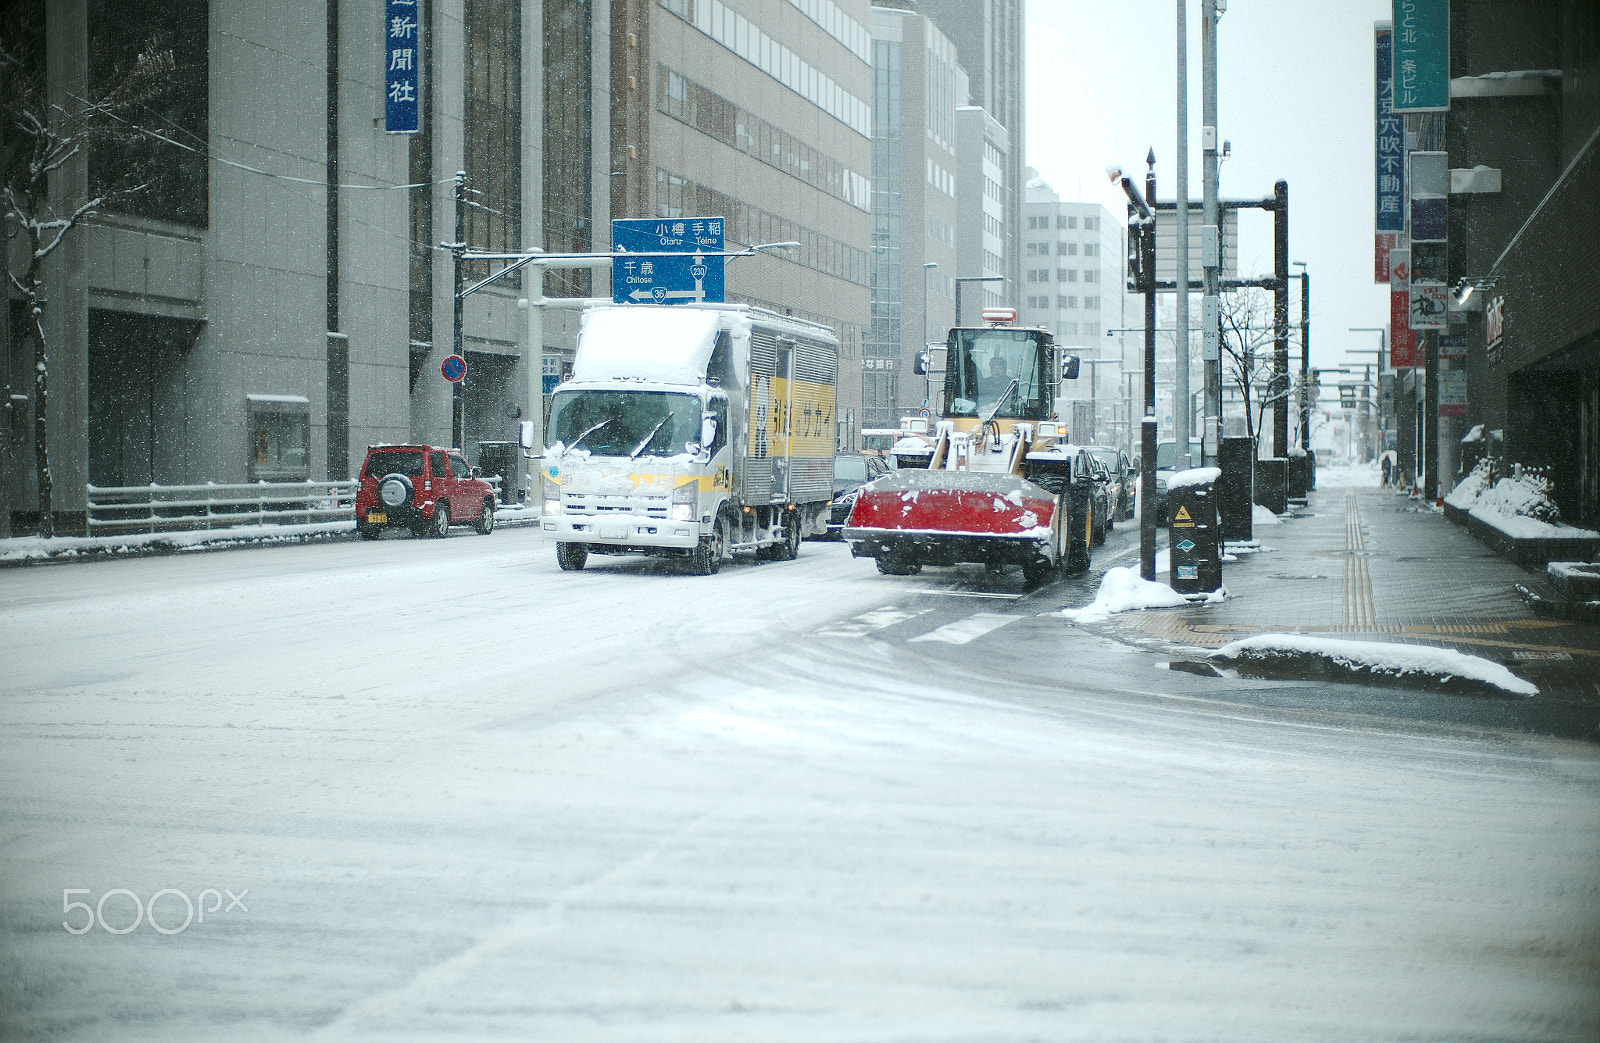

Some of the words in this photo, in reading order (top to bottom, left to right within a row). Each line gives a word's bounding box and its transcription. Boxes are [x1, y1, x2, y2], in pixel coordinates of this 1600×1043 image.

[388, 0, 417, 103] 新聞社
[655, 223, 685, 236] 小樽
[692, 222, 721, 236] 手稲
[660, 236, 682, 246] Otaru
[696, 236, 718, 246] Teine
[624, 261, 654, 275] 千歳
[693, 267, 705, 276] 230
[626, 276, 653, 284] Chitose
[654, 289, 665, 299] 36
